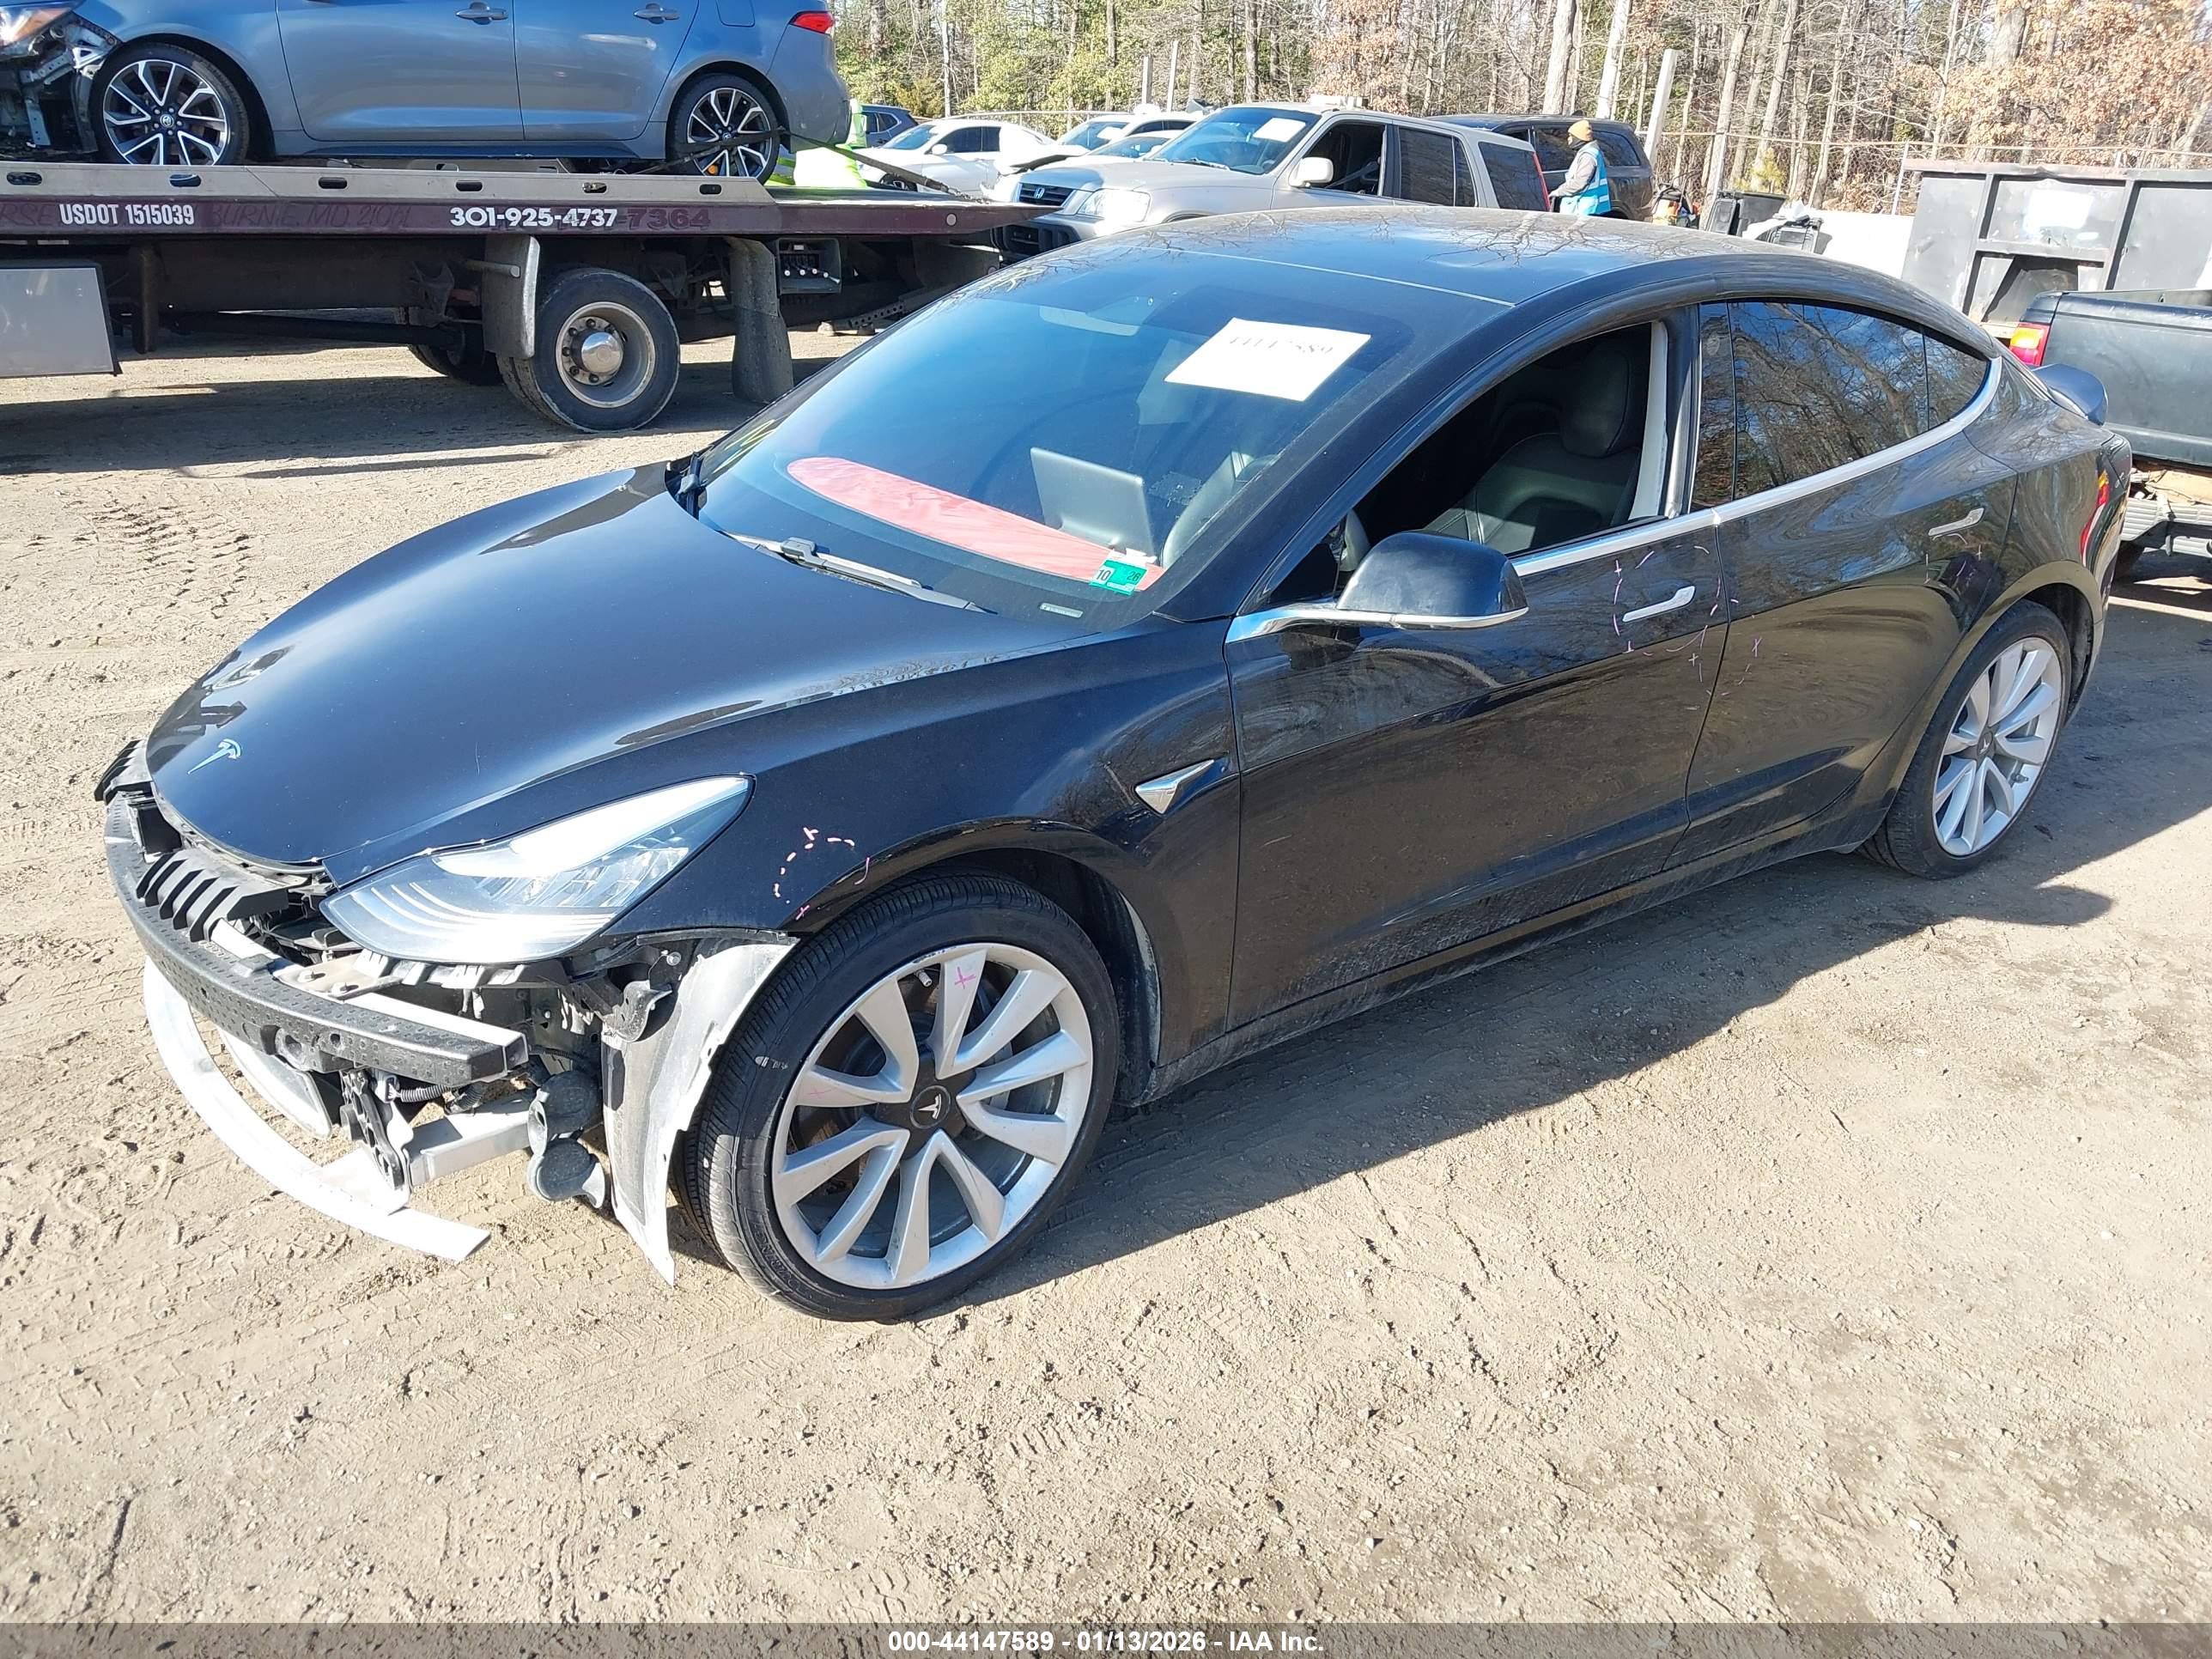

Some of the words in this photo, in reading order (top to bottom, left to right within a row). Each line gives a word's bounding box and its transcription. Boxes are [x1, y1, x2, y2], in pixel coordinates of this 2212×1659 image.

[59, 204, 118, 225] USDOT
[125, 204, 194, 226] 1515039
[450, 207, 618, 227] 301-925-4737
[1096, 569, 1112, 581] 10
[1126, 570, 1141, 581] 26
